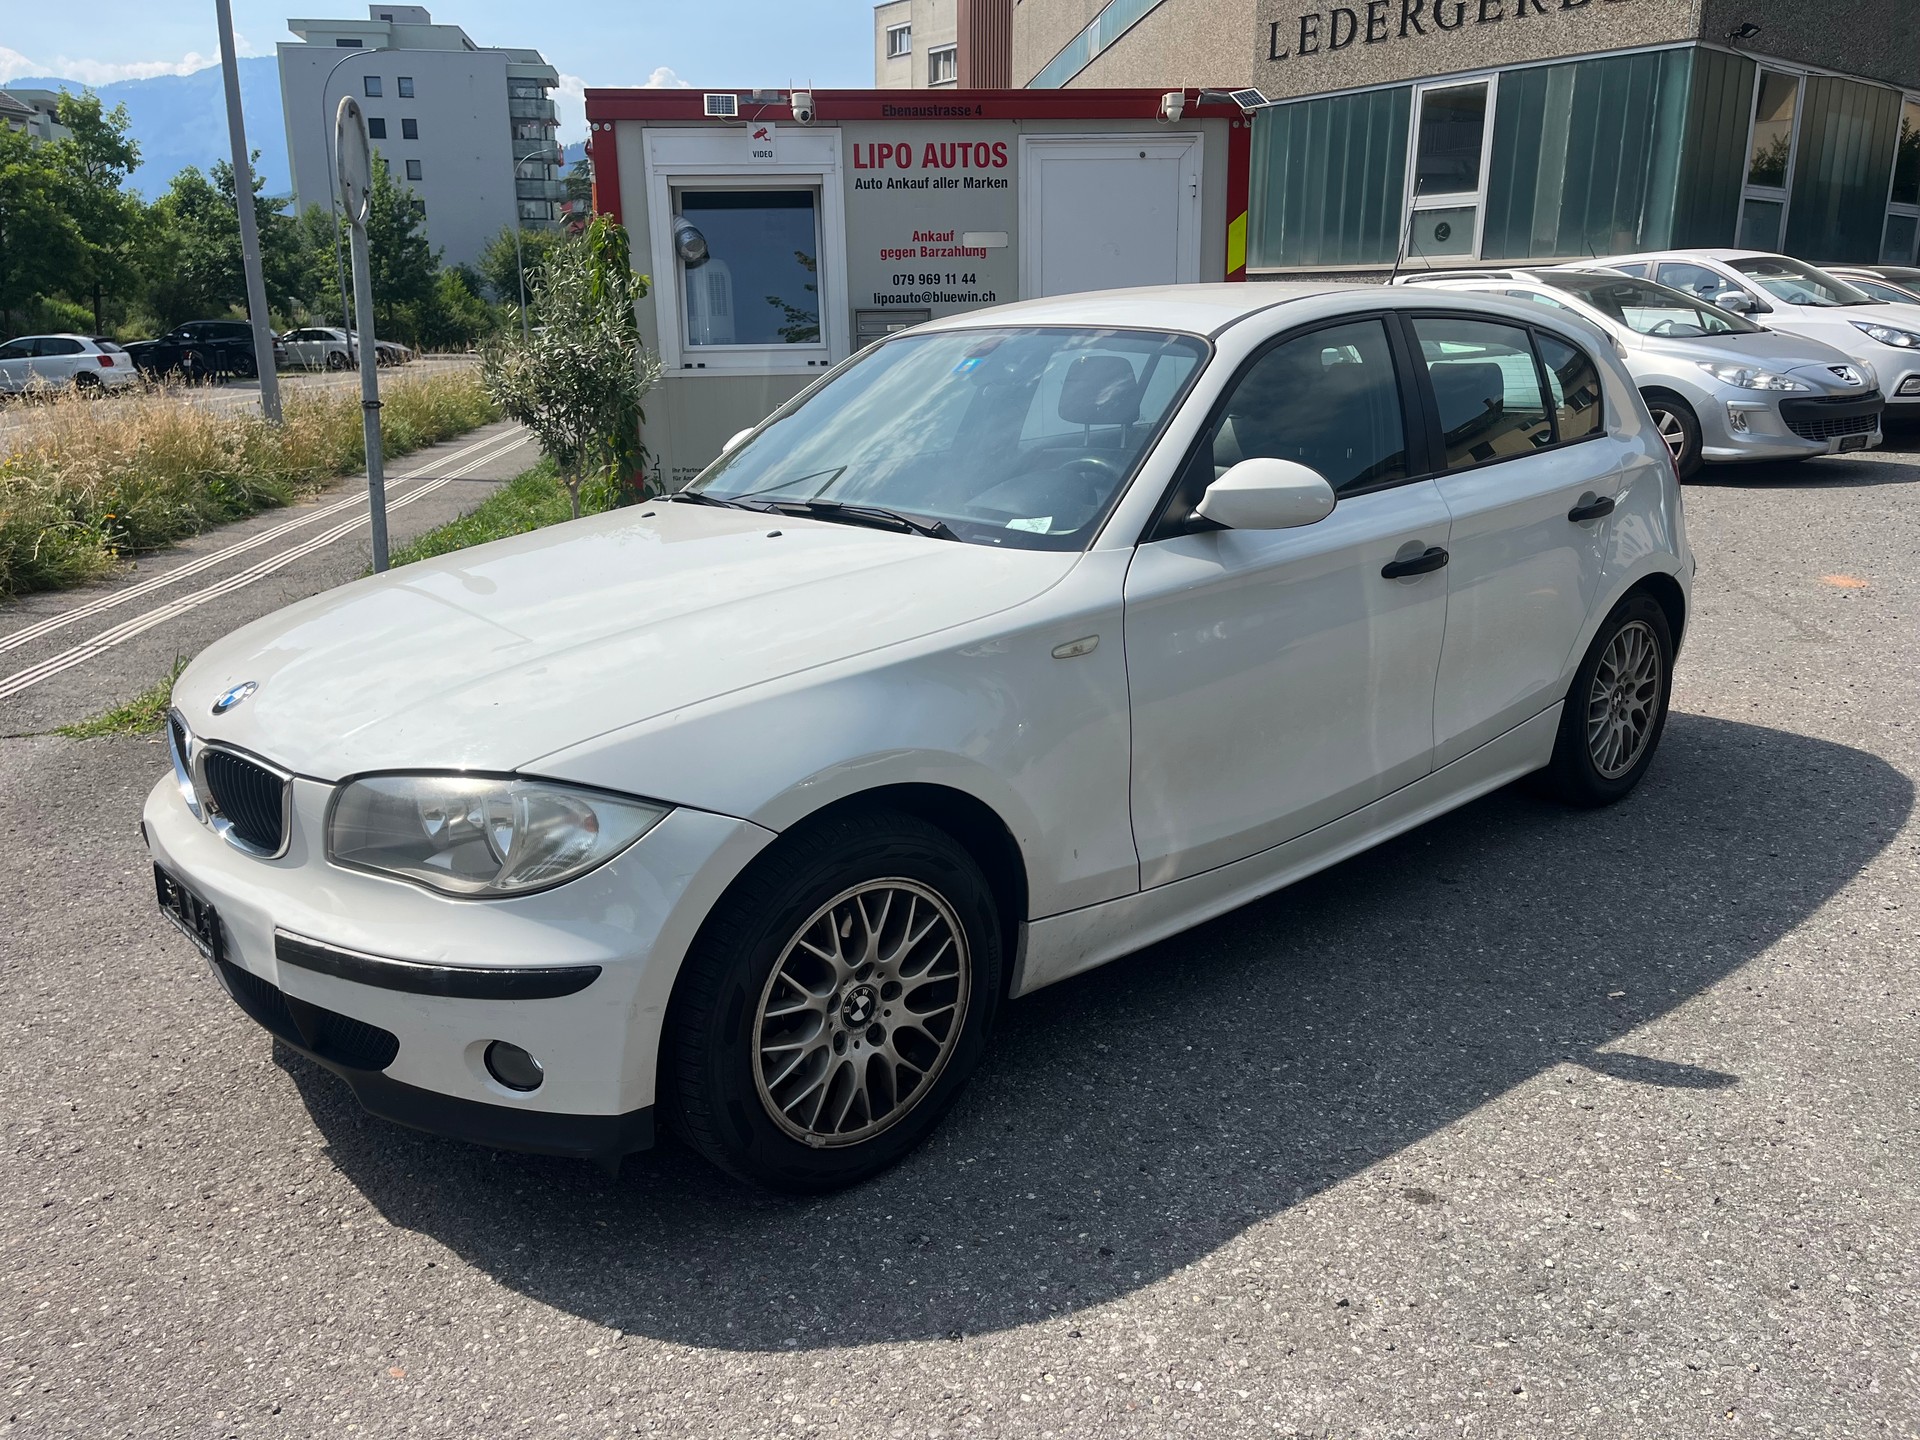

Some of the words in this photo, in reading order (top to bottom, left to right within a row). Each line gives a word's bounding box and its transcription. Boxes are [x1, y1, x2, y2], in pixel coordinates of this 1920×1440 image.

[1266, 0, 1593, 62] LEDERGE
[882, 104, 971, 117] Ebenaustrasse
[975, 104, 982, 116] 4
[752, 150, 773, 158] VIDEO
[853, 143, 912, 169] LIPO
[921, 142, 1008, 169] AUTOS
[855, 178, 883, 190] Auto
[886, 177, 930, 190] Ankauf
[933, 177, 960, 189] aller
[963, 177, 1008, 189] Marken
[912, 230, 955, 242] Ankauf
[880, 247, 916, 260] gegen
[920, 245, 987, 259] Barzahlung
[892, 274, 915, 286] 079
[918, 273, 941, 285] 969
[945, 273, 957, 285] 11
[961, 273, 977, 285] 44
[873, 290, 996, 306] lipoauto@bluewin.ch
[843, 989, 869, 1013] BMW
